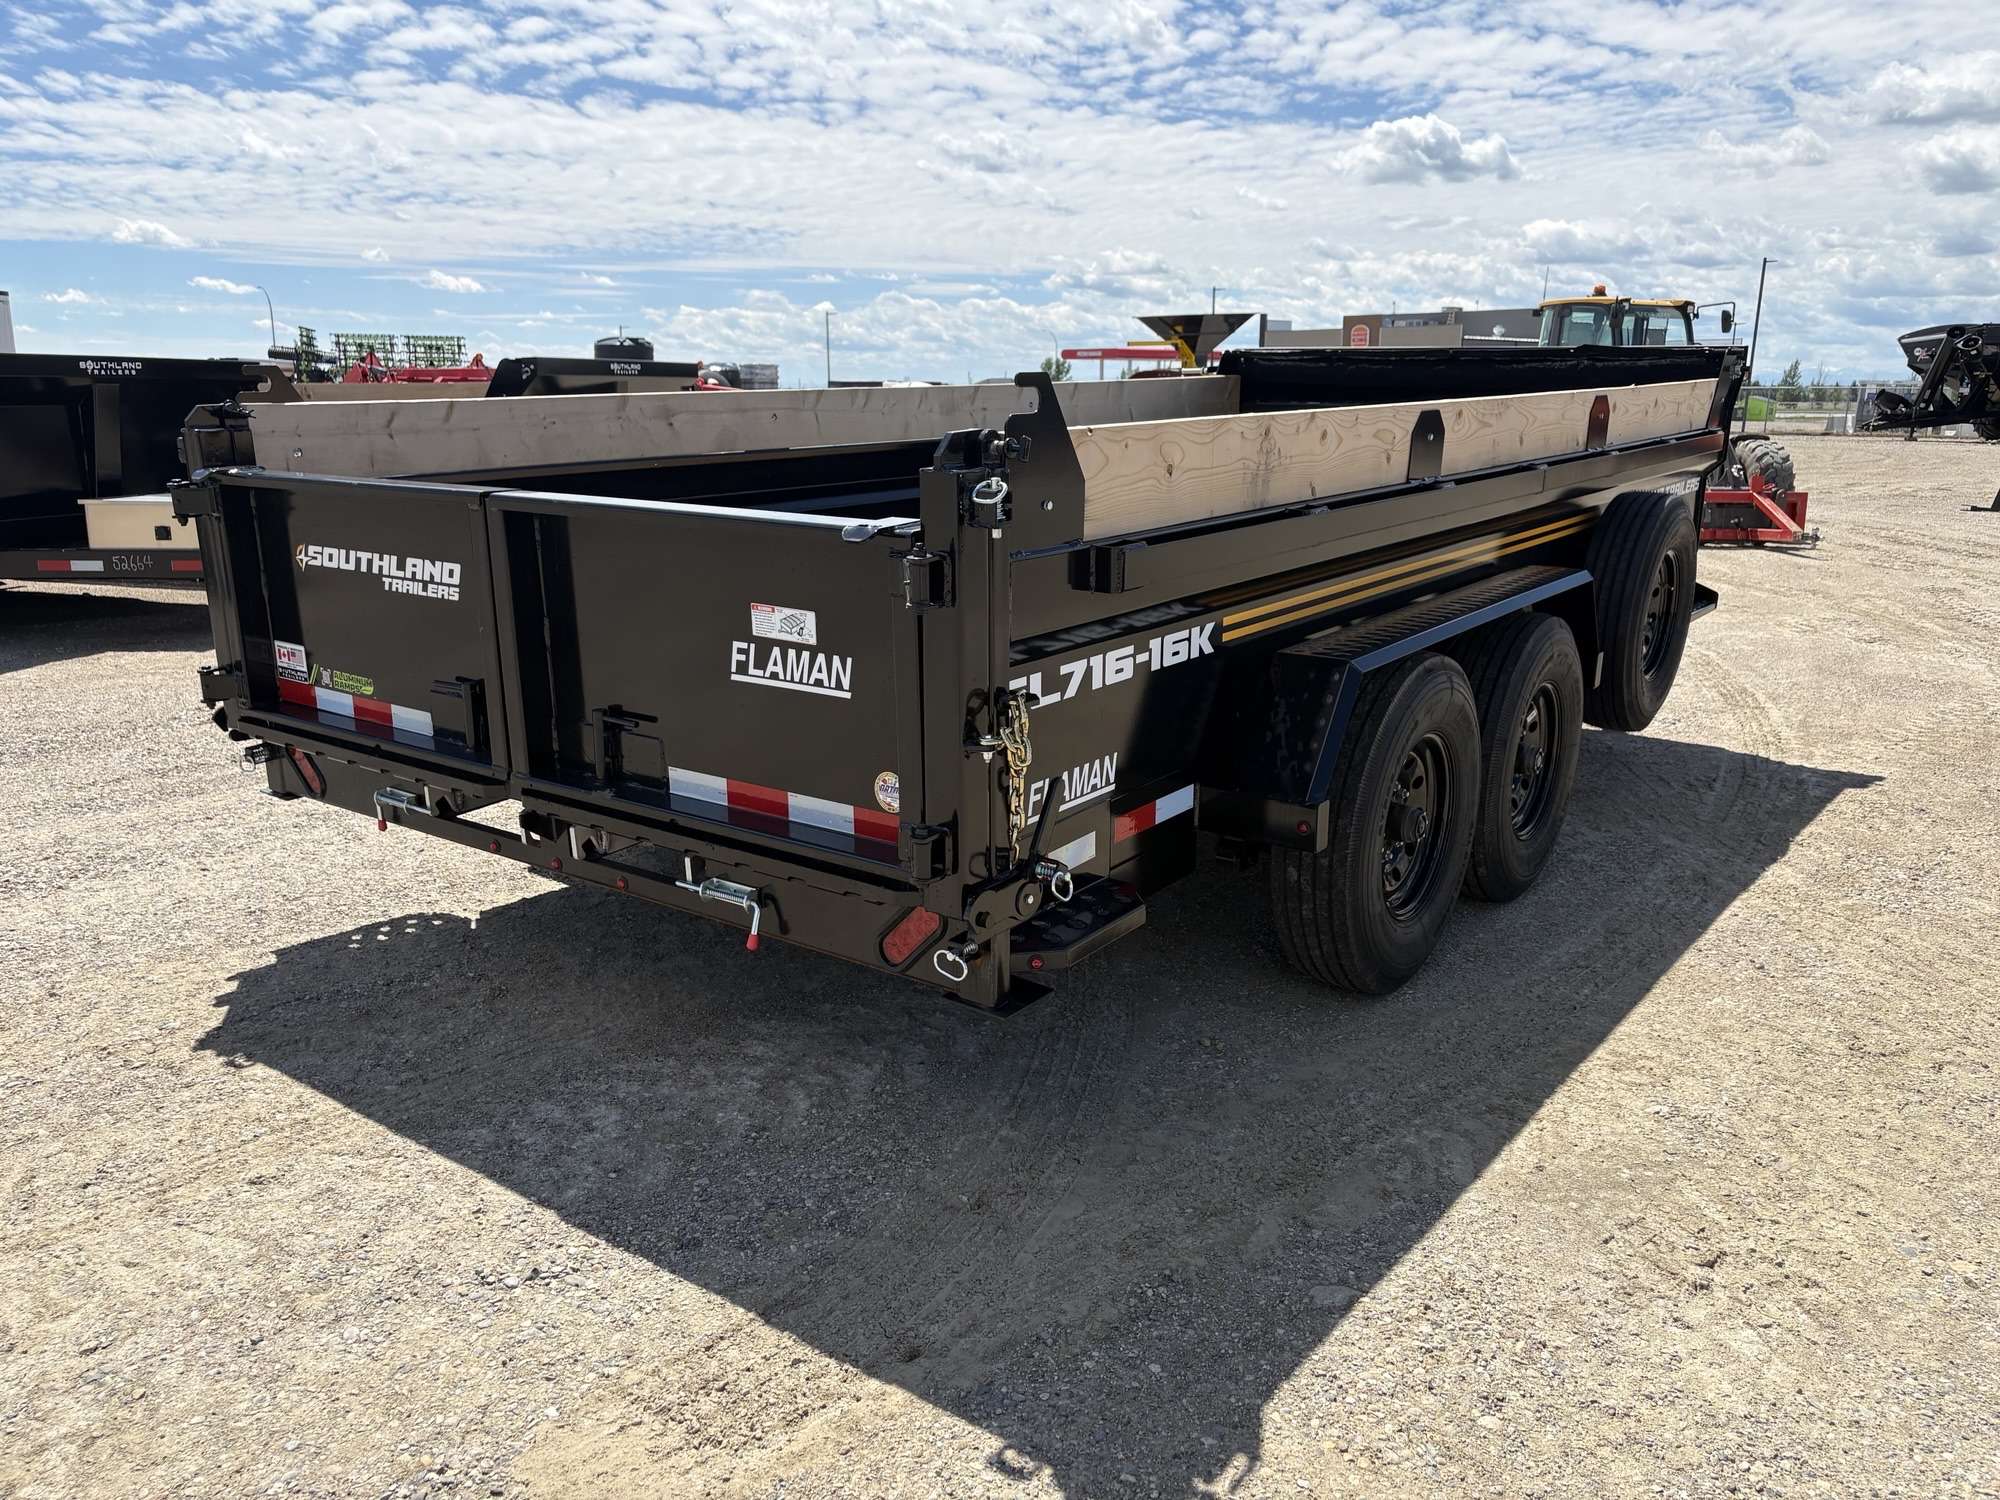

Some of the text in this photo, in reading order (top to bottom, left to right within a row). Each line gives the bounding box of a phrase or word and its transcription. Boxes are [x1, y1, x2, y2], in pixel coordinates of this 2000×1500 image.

[79, 360, 142, 370] SOUTHLAND
[112, 554, 153, 571] 52664
[307, 545, 461, 585] SOUTHLAND
[382, 577, 460, 601] TRAILERS
[730, 640, 853, 691] FLAMAN
